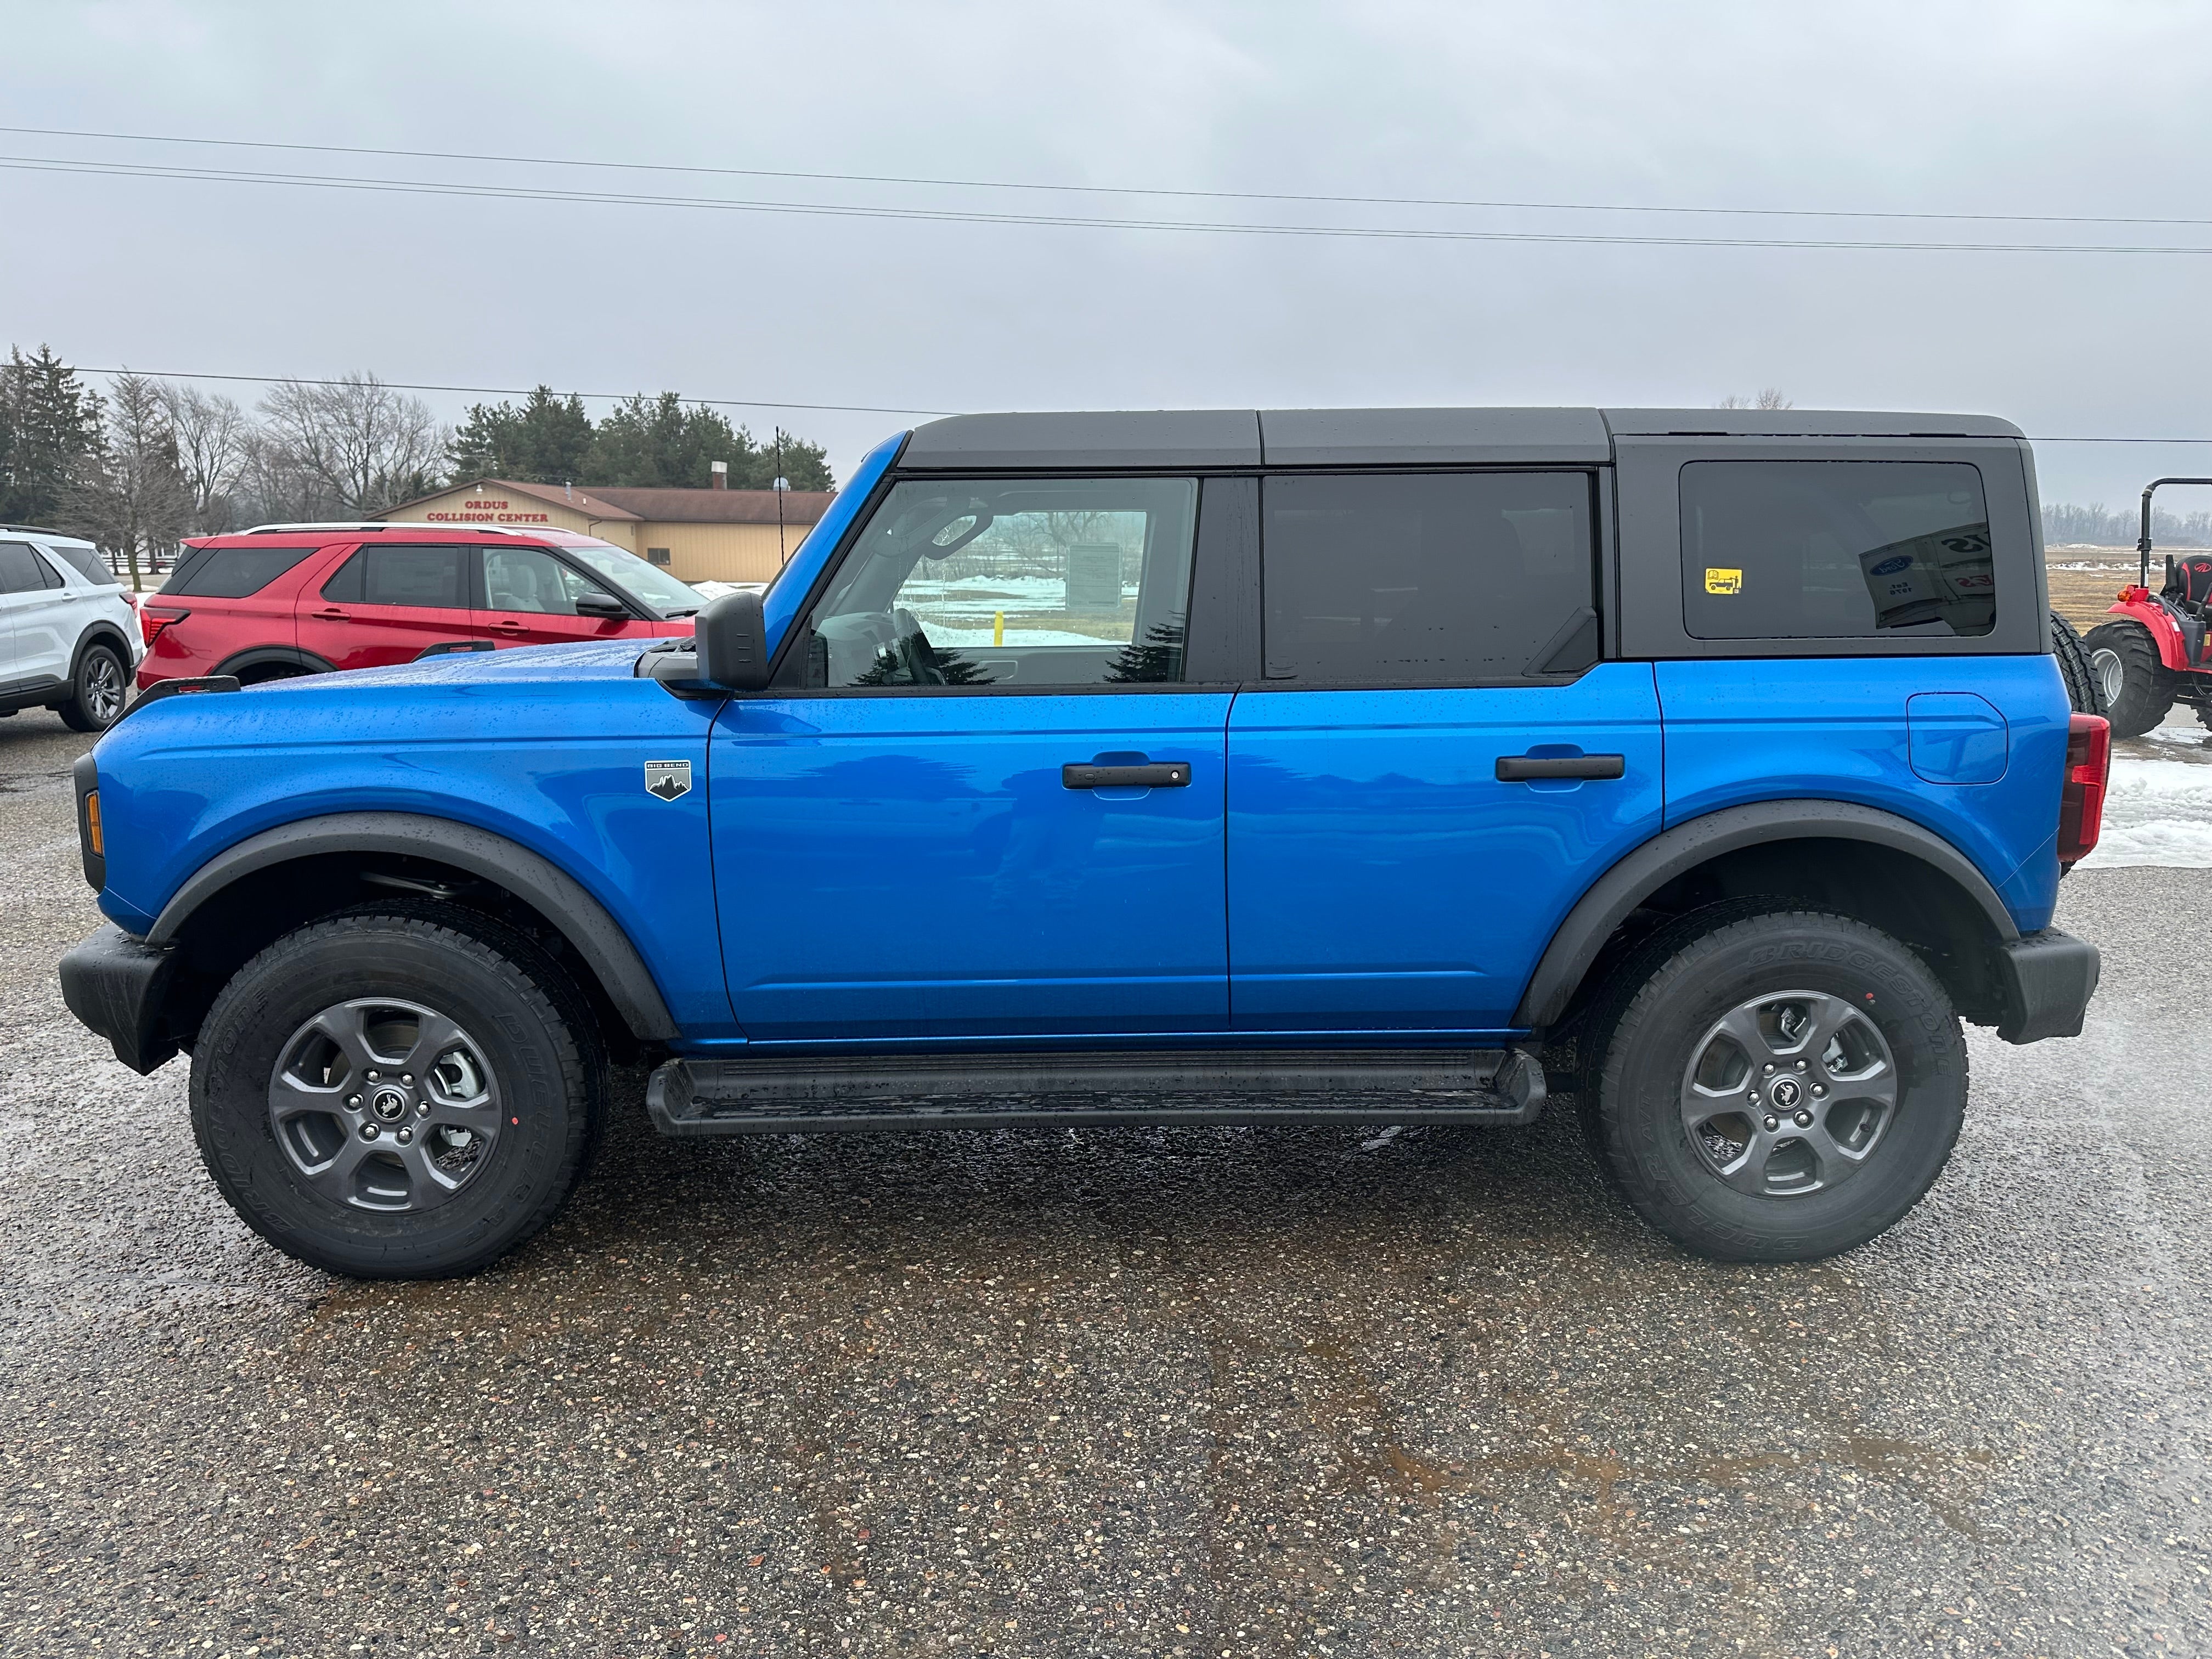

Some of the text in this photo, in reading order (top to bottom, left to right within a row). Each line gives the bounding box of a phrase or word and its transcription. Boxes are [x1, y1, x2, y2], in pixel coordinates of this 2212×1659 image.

[427, 513, 548, 522] COLLISION CENTER
[465, 501, 508, 510] ORDUS
[1748, 942, 1952, 1076] BRIDGESTONE
[210, 989, 295, 1233] BRIDGESTONE
[494, 1012, 552, 1204] DUELER
[1647, 1154, 1809, 1251] DUELER
